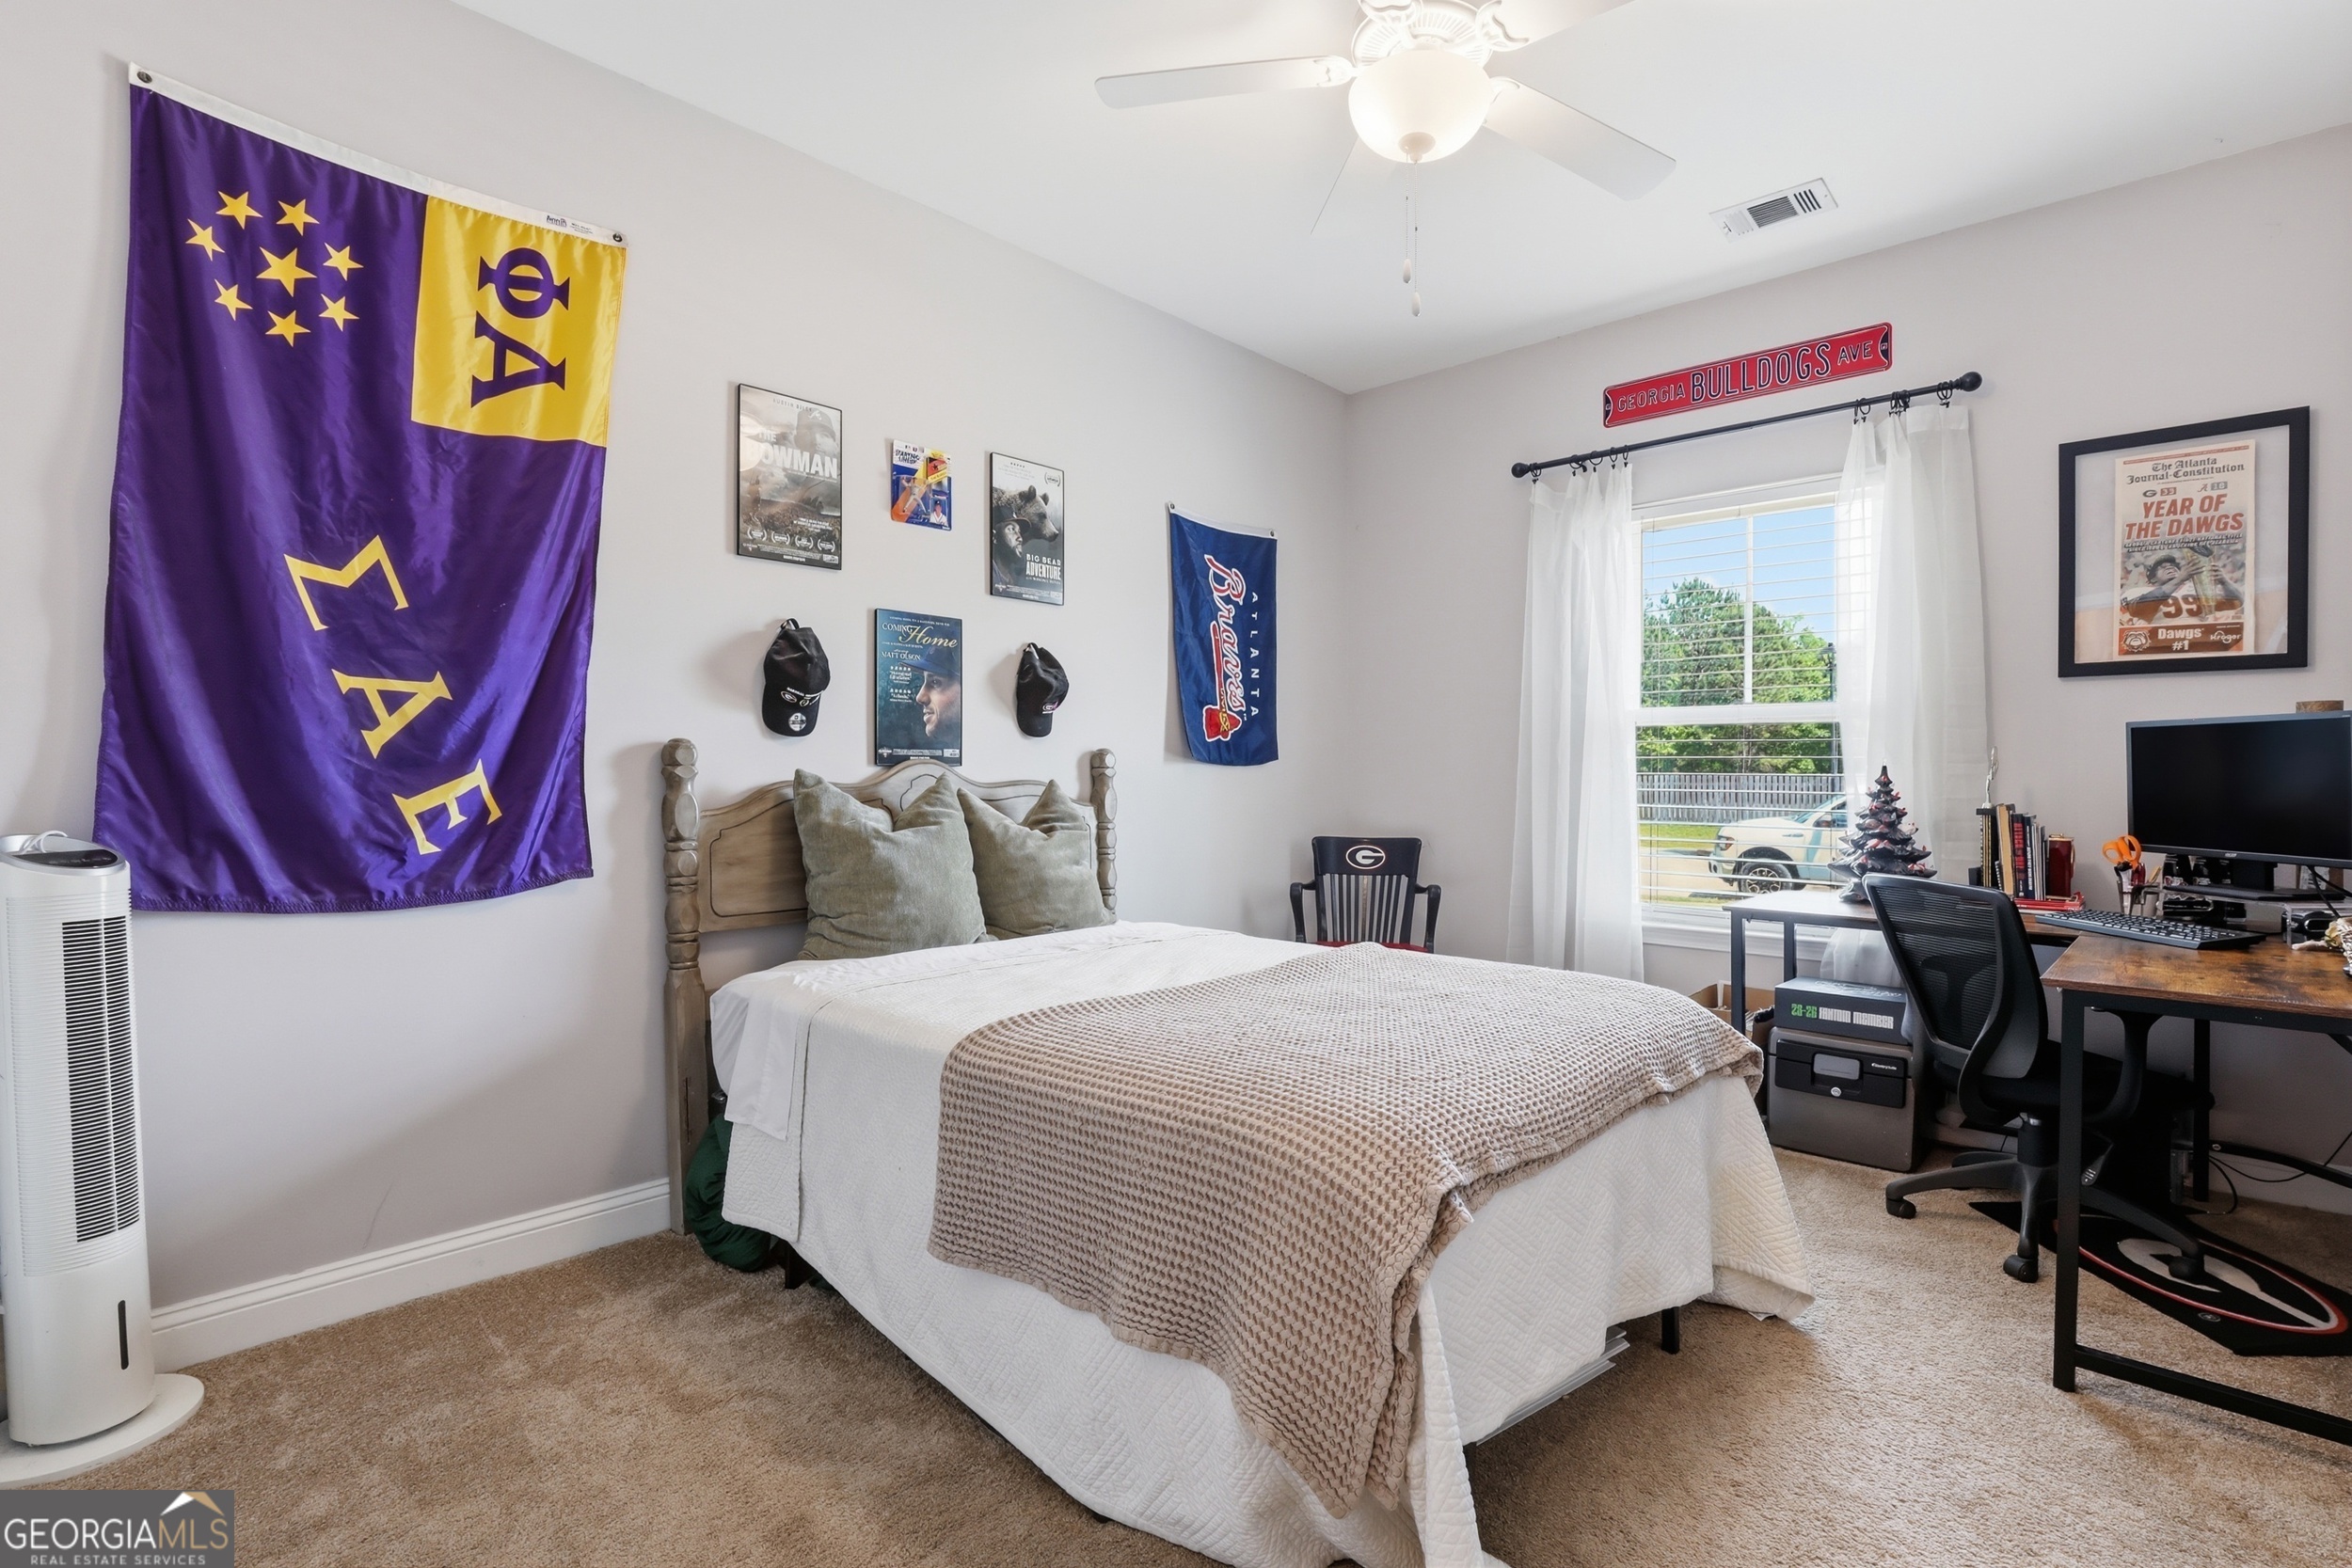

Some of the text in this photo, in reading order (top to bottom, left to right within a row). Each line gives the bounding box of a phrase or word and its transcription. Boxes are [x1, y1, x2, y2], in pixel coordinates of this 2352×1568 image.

[1618, 341, 1873, 412] GEORGIA BULLDOGS AVE
[2126, 464, 2245, 484] Journal-Constitution
[2152, 457, 2217, 472] The Atlanta
[2143, 494, 2227, 519] YEAR OF
[2126, 513, 2244, 540] THE DAWGS
[1026, 554, 1061, 566] BIG BEAR
[1026, 562, 1061, 580] ADVENTURE
[2162, 594, 2203, 619] 99
[882, 622, 913, 633] COMING
[898, 625, 958, 648] Home
[1204, 554, 1246, 712] Braves
[2157, 627, 2202, 640] Dawgs
[2211, 630, 2241, 643] Kroger
[1250, 592, 1261, 716] ATLANTA
[2172, 641, 2189, 651] #1
